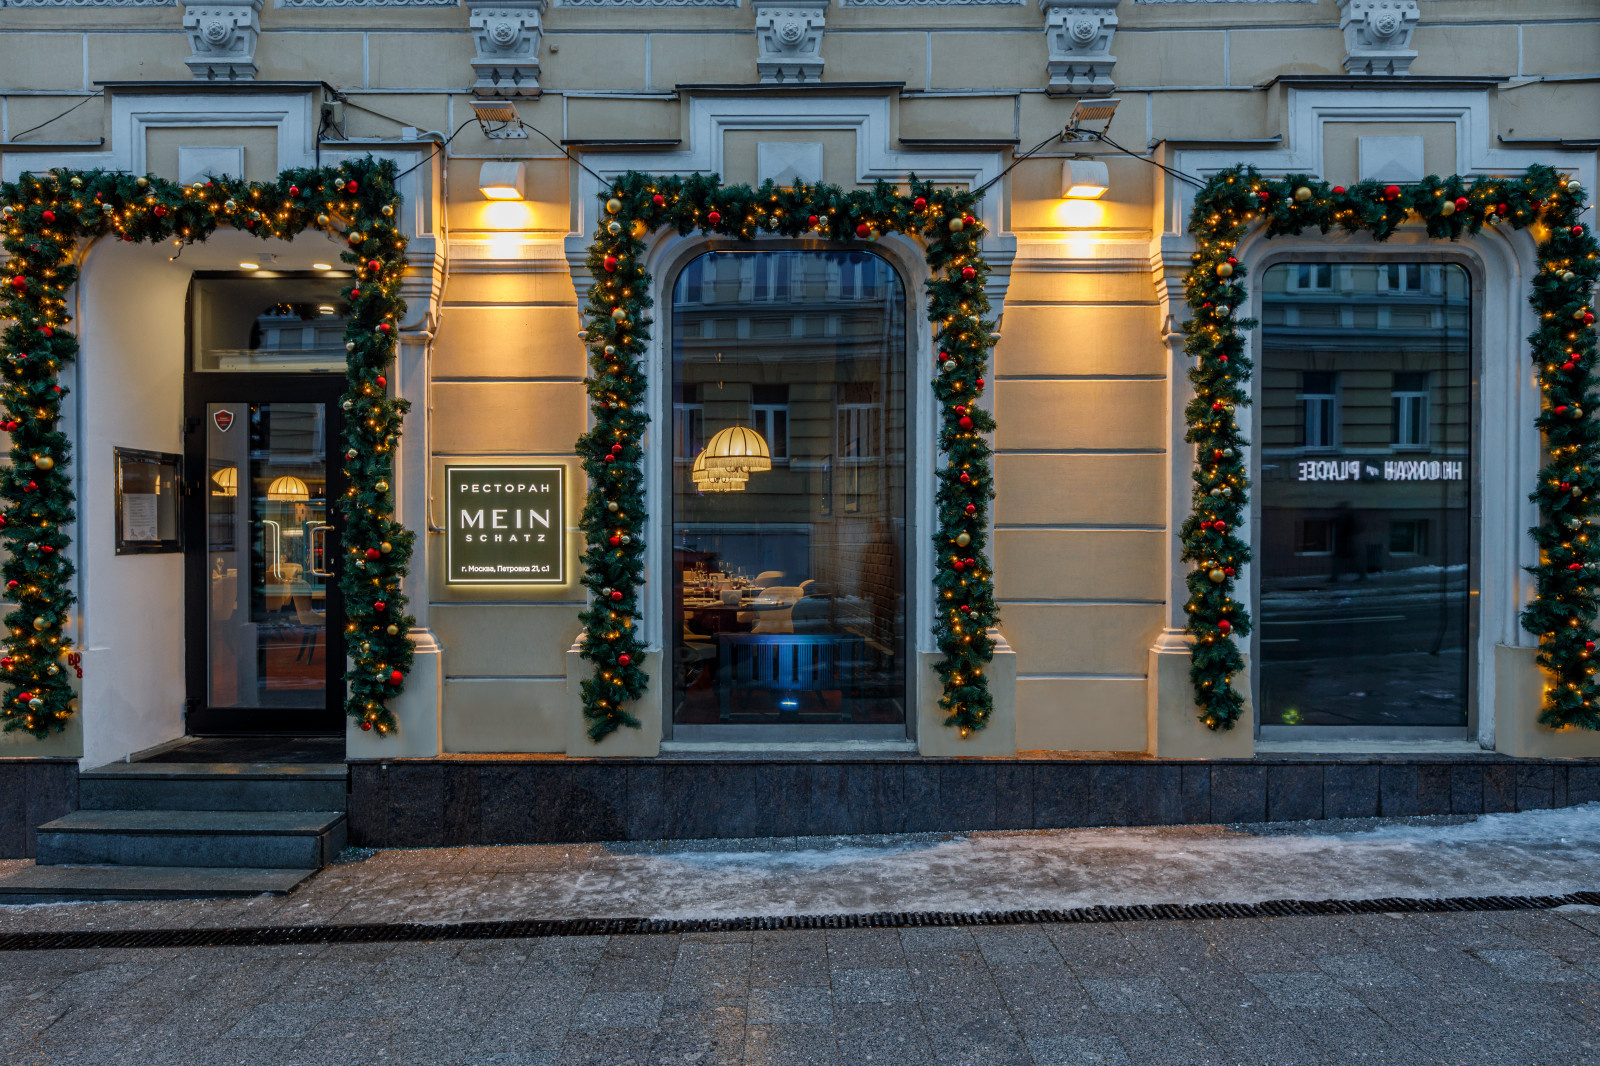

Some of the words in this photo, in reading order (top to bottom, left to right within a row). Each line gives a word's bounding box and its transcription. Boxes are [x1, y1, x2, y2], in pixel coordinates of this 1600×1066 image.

[460, 484, 550, 493] РЕСТОРАН
[461, 509, 550, 529] MEIN
[465, 534, 546, 542] SCHATZ
[468, 565, 496, 573] Москва,
[497, 565, 531, 573] Петровка
